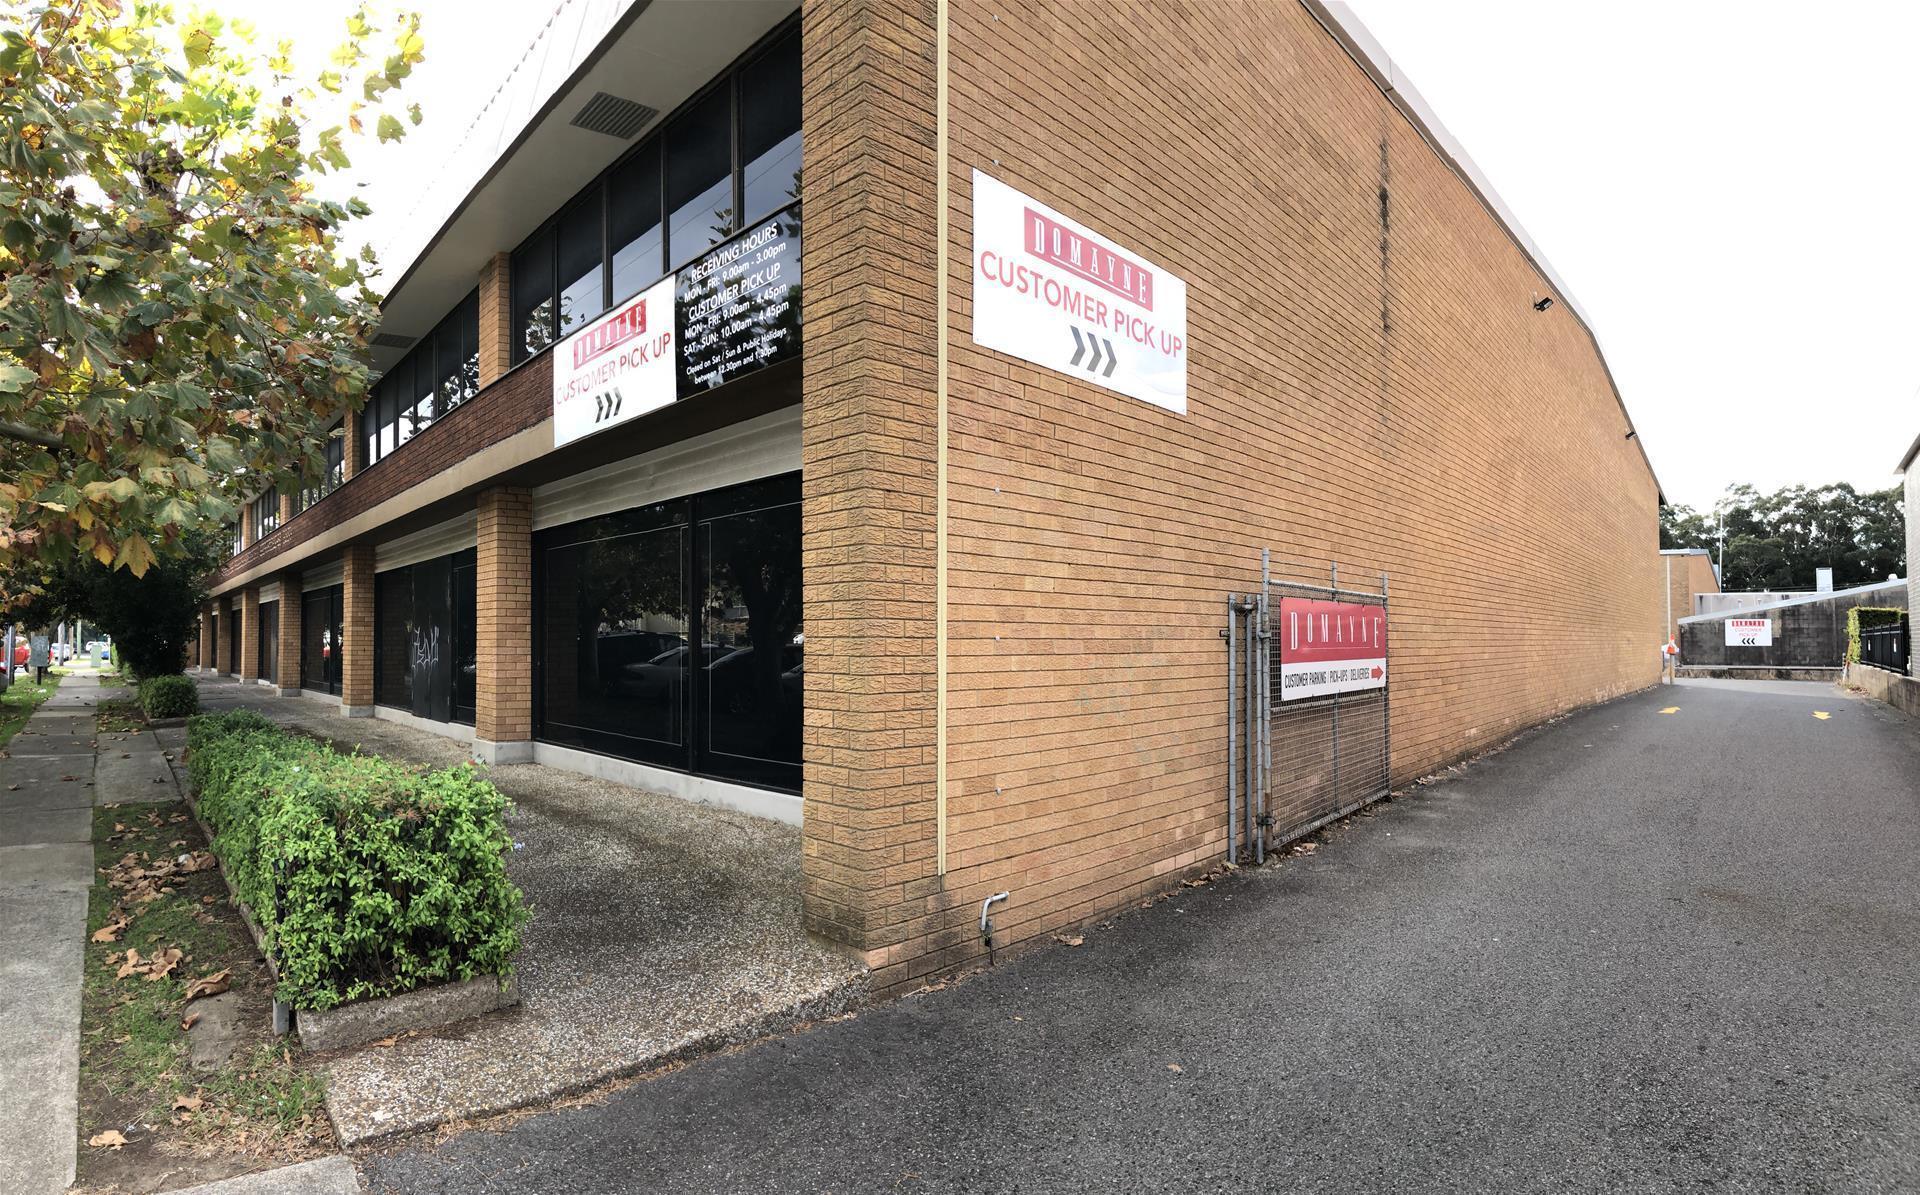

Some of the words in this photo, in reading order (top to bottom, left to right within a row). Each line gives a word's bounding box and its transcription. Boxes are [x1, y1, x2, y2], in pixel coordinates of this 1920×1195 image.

[684, 285, 702, 303] MON
[723, 262, 749, 282] 9.00am
[756, 242, 786, 264] 3.00pm
[691, 245, 740, 282] RECEIVING
[742, 222, 777, 253] HOURS
[1034, 216, 1147, 303] DOMAYNE
[684, 323, 703, 340] MON
[708, 315, 721, 329] FRI:
[723, 301, 750, 320] 9.00am
[756, 283, 787, 303] 4.45pm
[689, 285, 739, 320] CUSTOMER
[741, 271, 764, 293] PICK
[766, 262, 781, 280] UP
[980, 250, 1108, 328] CUSTOMER
[1114, 308, 1155, 349] PICK
[1161, 330, 1182, 358] UP
[577, 305, 642, 366] DOMAYNE
[686, 361, 704, 375] Closed
[703, 360, 712, 368] on
[711, 354, 721, 365] Sat
[725, 348, 736, 359] Sun
[742, 336, 761, 351] Public
[761, 327, 787, 343] Holidays
[701, 332, 719, 349] SUN:
[721, 317, 753, 339] 10.00am
[759, 301, 789, 321] 4.45pm
[556, 359, 616, 405] CUSTOMER
[619, 343, 649, 376] PICK
[653, 332, 671, 358] UP
[718, 358, 743, 375] 12.30pm
[743, 352, 754, 363] and
[1290, 611, 1379, 650] DOMAYNE
[1285, 672, 1308, 688] CUSTOMER
[1309, 671, 1327, 686] PARKING
